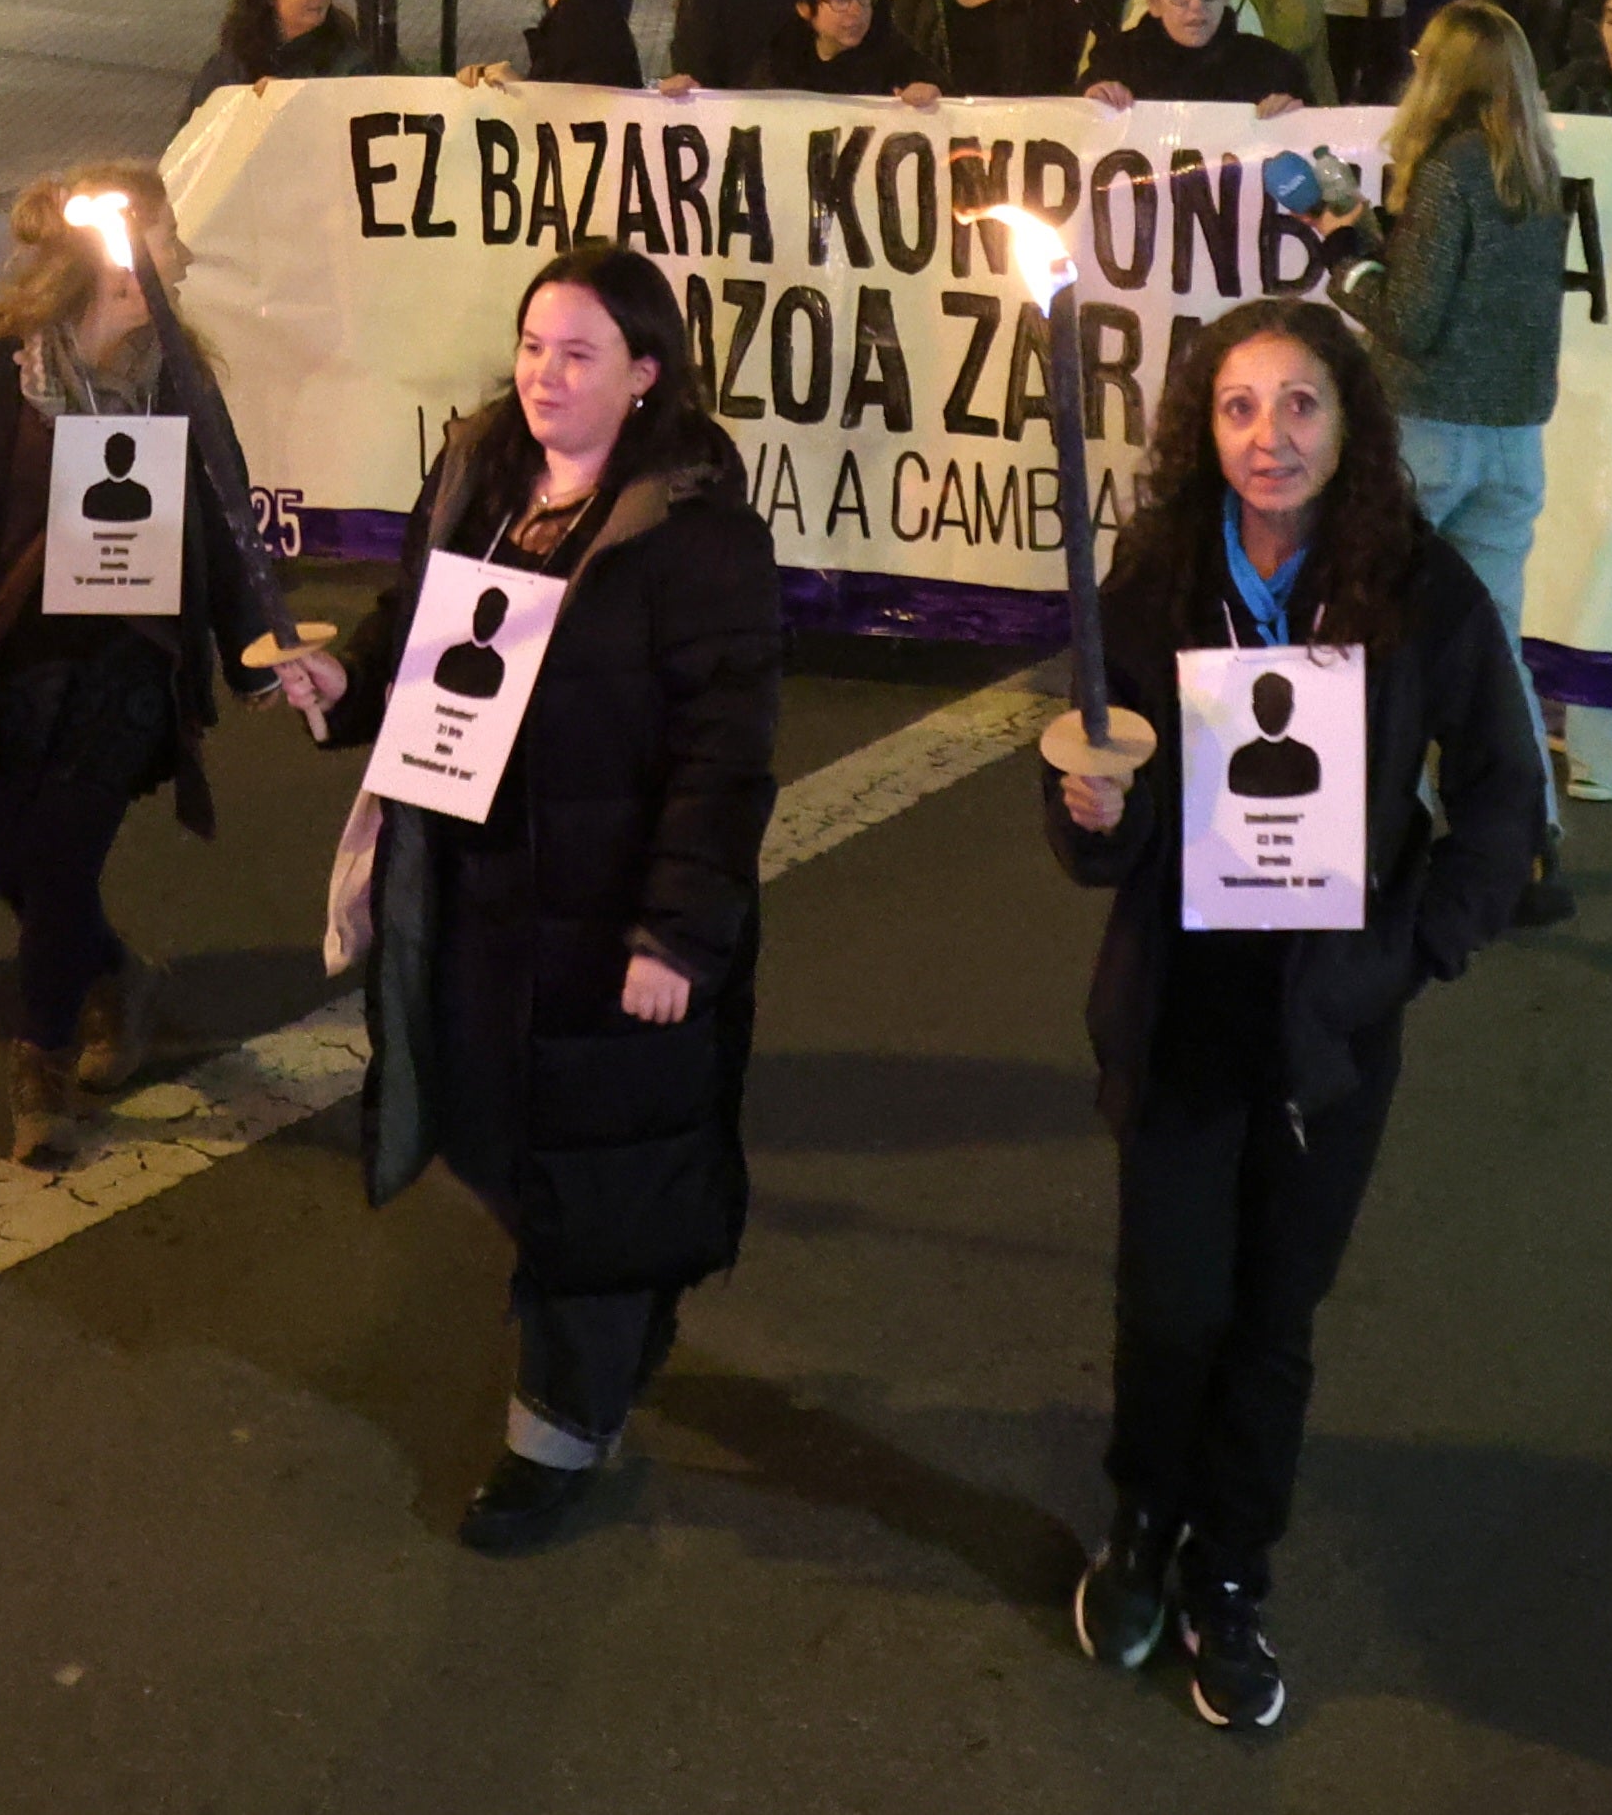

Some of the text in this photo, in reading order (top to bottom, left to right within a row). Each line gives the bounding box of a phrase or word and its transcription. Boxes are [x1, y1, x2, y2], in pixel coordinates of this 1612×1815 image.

[350, 112, 1608, 324] EZ BAZARA KONPONBA
[686, 274, 1202, 446] AZOA ZAR
[826, 449, 871, 539] A
[892, 450, 1149, 552] CAMBA
